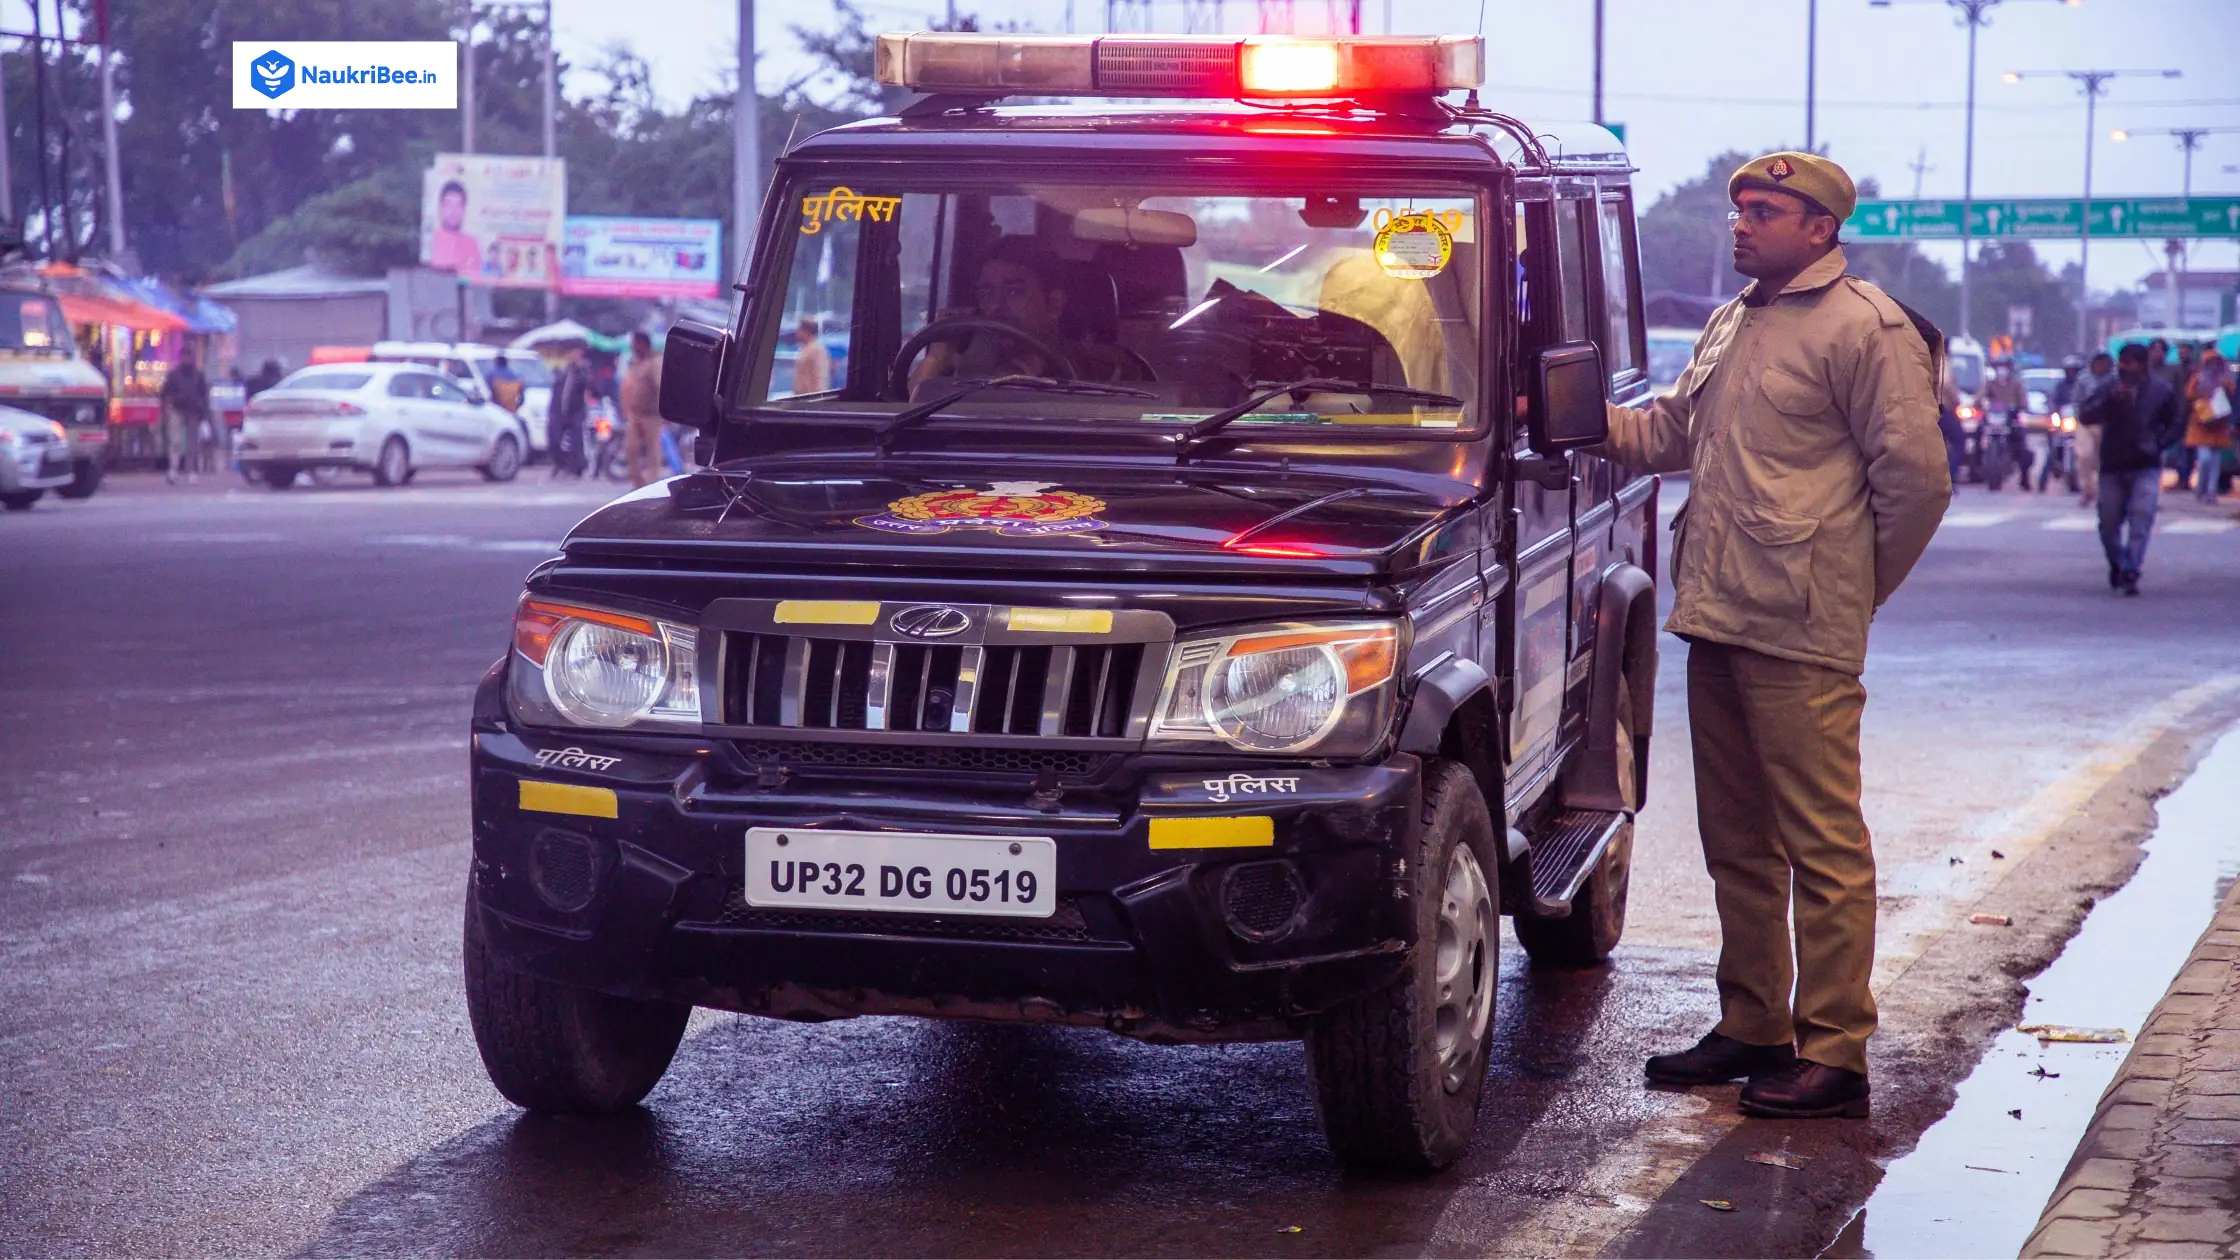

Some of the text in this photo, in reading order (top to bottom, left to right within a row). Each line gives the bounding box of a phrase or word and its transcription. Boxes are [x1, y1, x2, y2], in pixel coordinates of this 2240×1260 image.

[800, 186, 901, 234] पुलिस
[1373, 207, 1463, 233] 0519
[535, 746, 622, 772] पुलिस
[1202, 773, 1300, 803] पुलिस
[770, 860, 1037, 904] UP32 DG 0519
